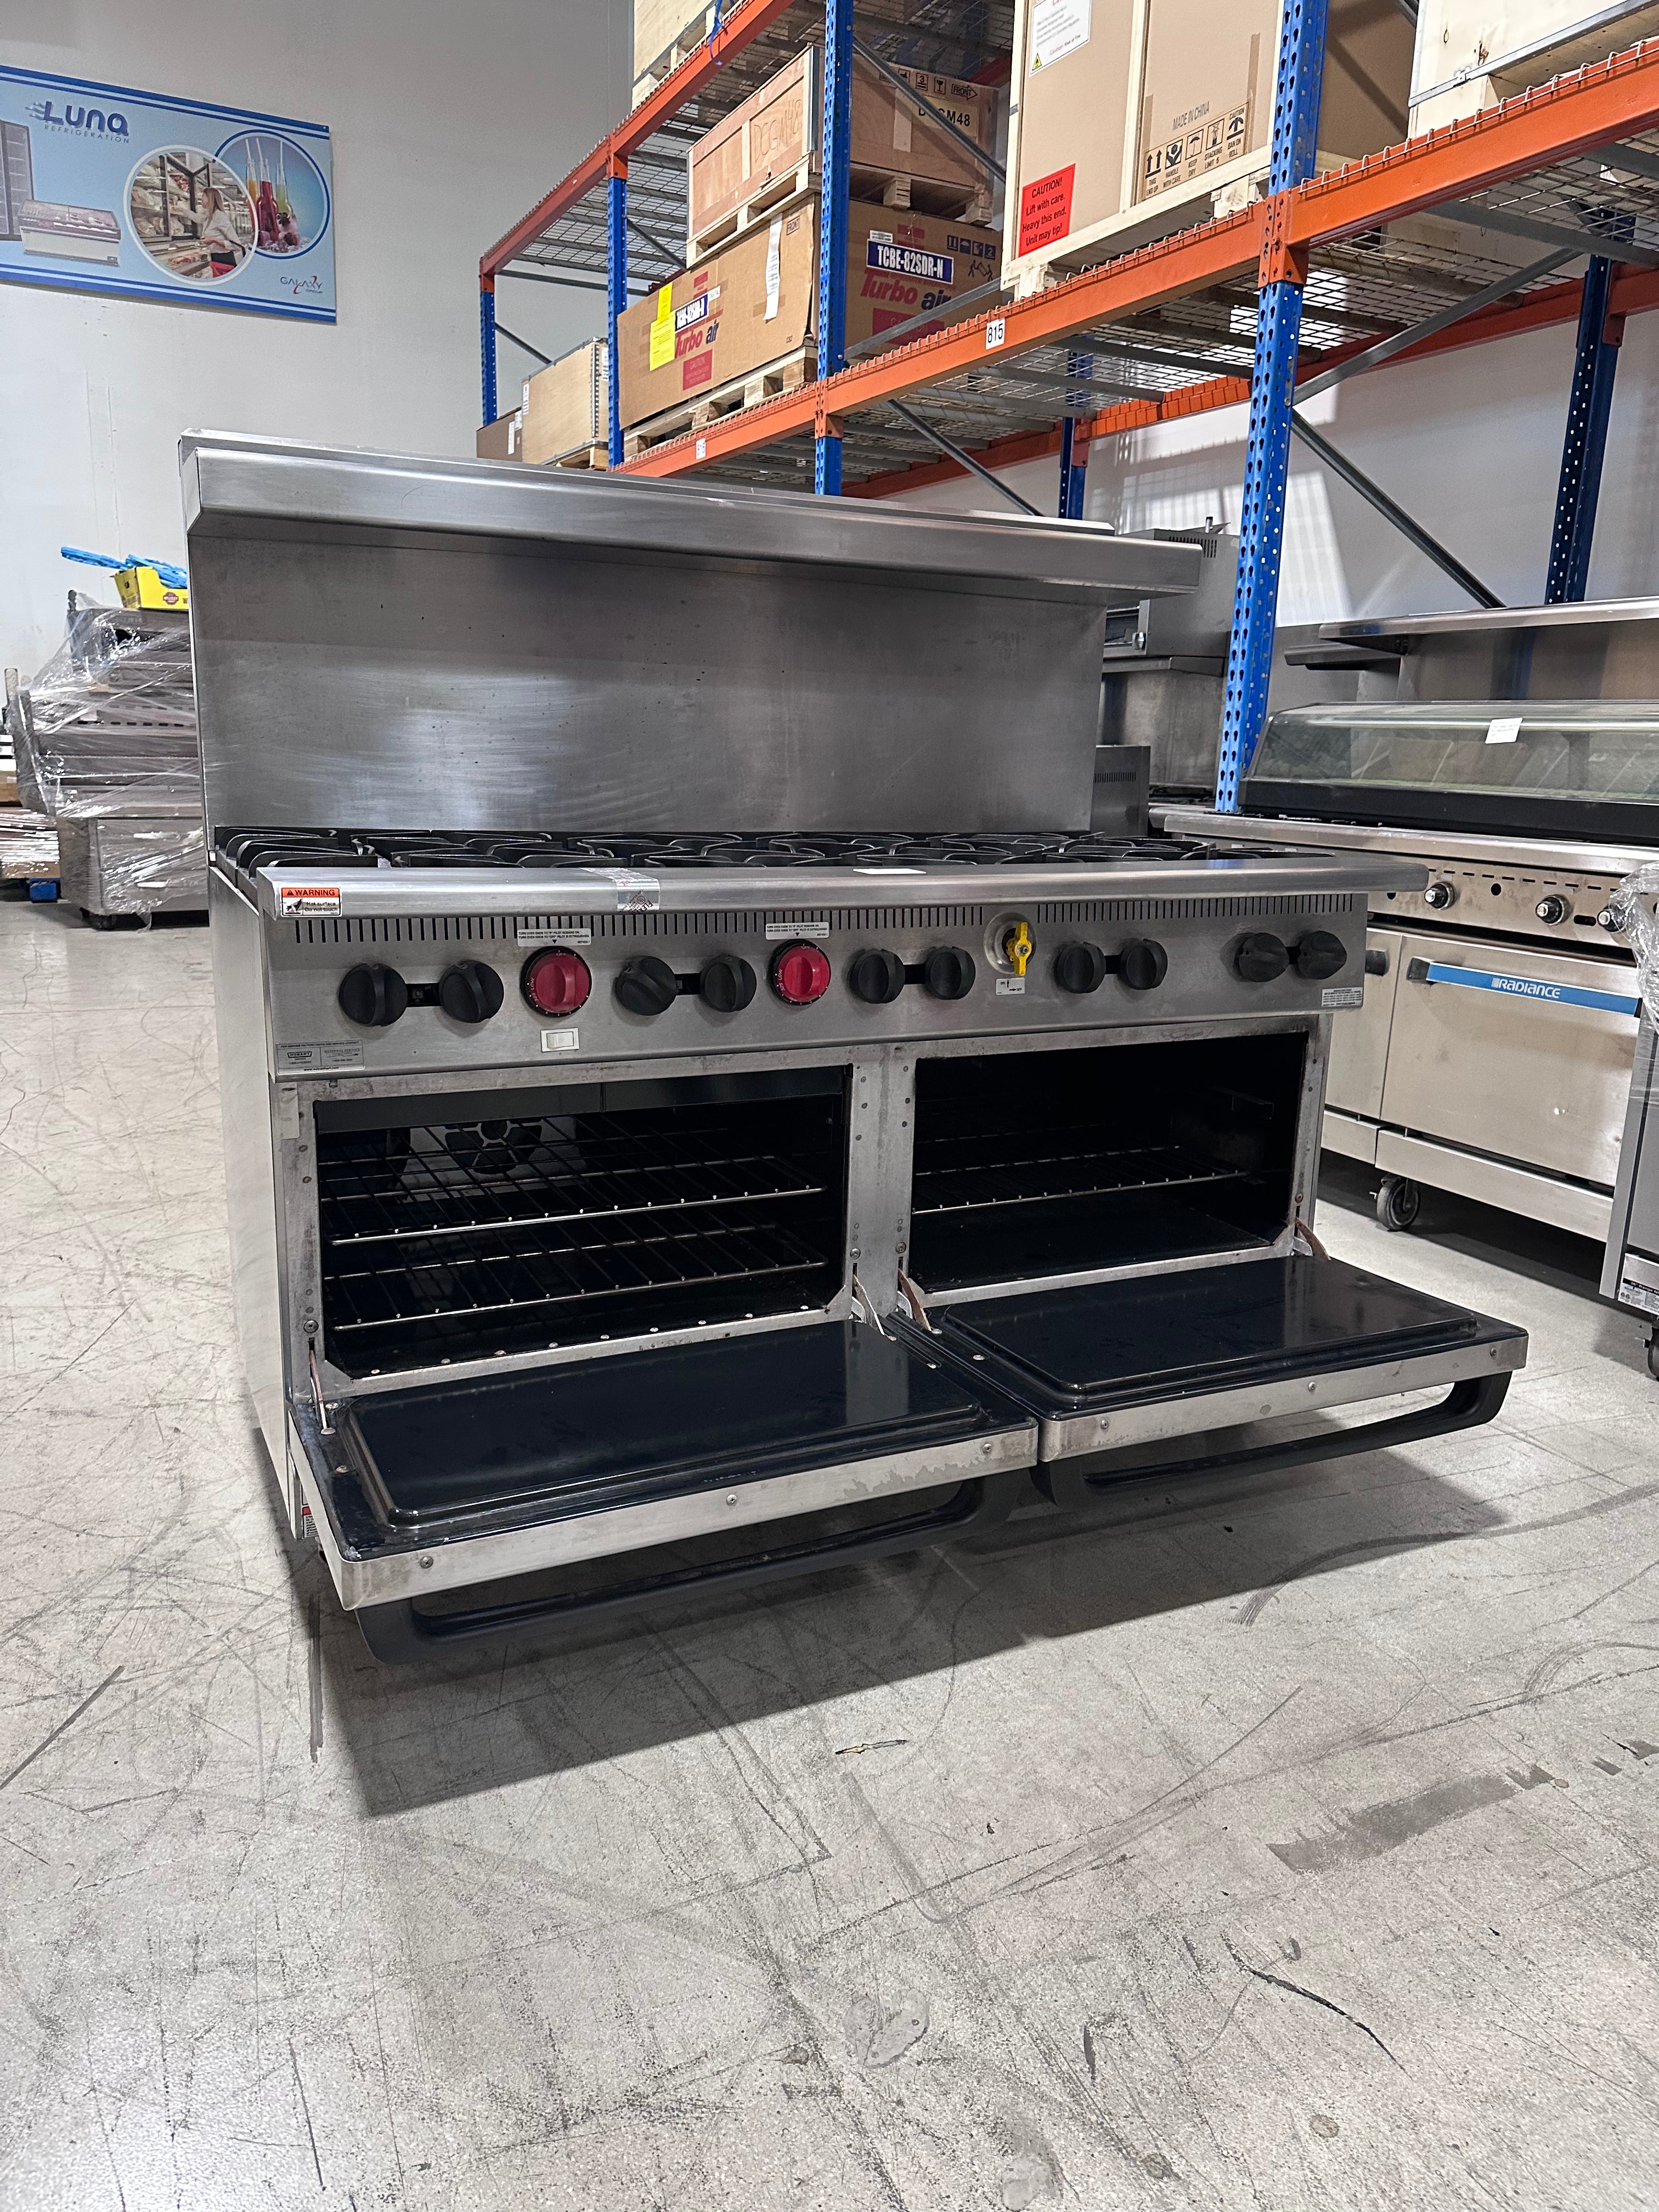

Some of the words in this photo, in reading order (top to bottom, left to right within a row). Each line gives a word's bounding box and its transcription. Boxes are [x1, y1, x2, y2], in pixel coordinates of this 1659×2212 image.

[1172, 112, 1188, 131] MADE
[1188, 109, 1194, 123] IN
[1194, 101, 1209, 120] CHINA
[44, 125, 129, 144] REFRIGERATION
[1204, 146, 1222, 161] STACKING
[1031, 176, 1063, 199] CAUTION!
[1026, 204, 1036, 216] Lift
[1037, 199, 1049, 211] with
[1051, 194, 1065, 205] care.
[1022, 219, 1040, 233] Heavy
[1041, 213, 1052, 225] this
[1053, 206, 1066, 219] end.
[1026, 234, 1038, 246] Unit
[1039, 229, 1051, 241] may
[1052, 222, 1062, 235] tip!
[877, 245, 944, 279] TCBE-82SDR-N
[860, 268, 918, 304] Turbo
[675, 330, 703, 359] Turbo
[706, 319, 719, 345] air
[988, 323, 1003, 343] 815
[1498, 978, 1561, 998] RADIANCE
